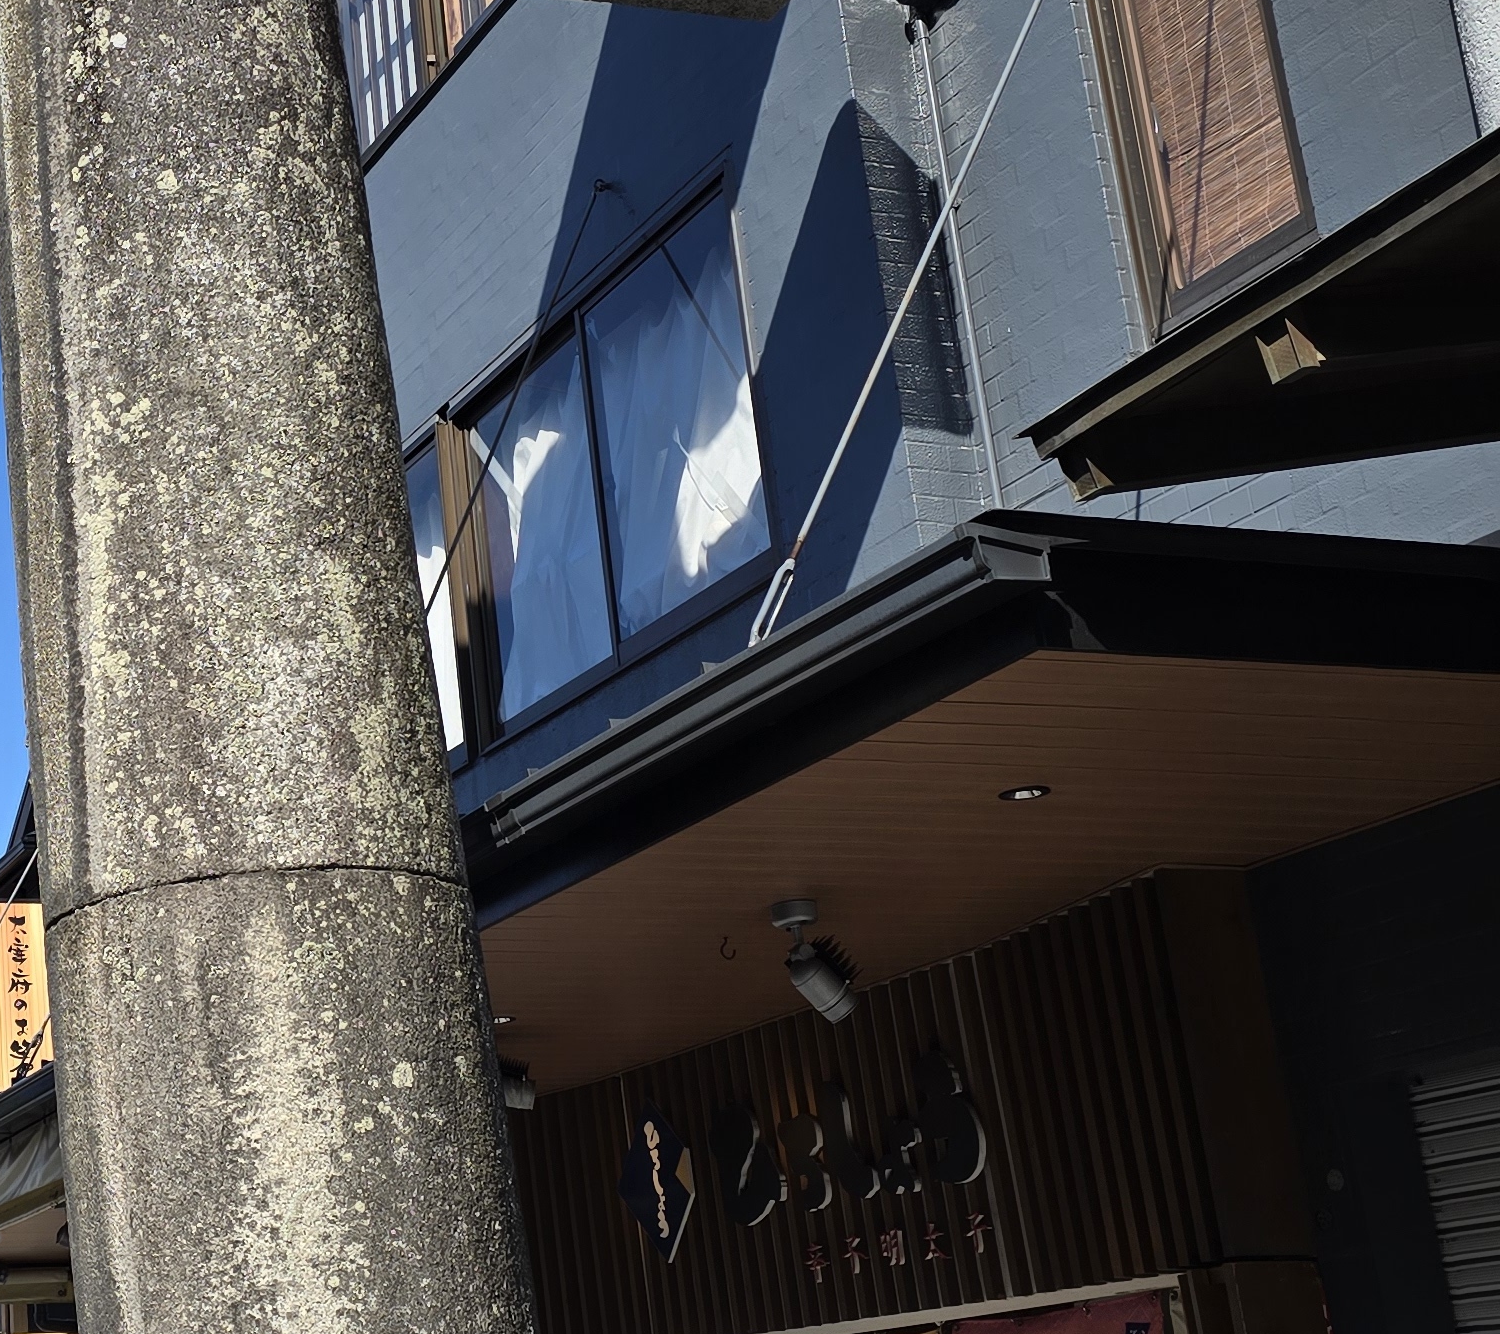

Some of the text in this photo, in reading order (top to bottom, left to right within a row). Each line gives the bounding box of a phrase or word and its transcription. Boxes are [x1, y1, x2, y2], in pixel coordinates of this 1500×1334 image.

[804, 1211, 993, 1285] 辛子明太子
